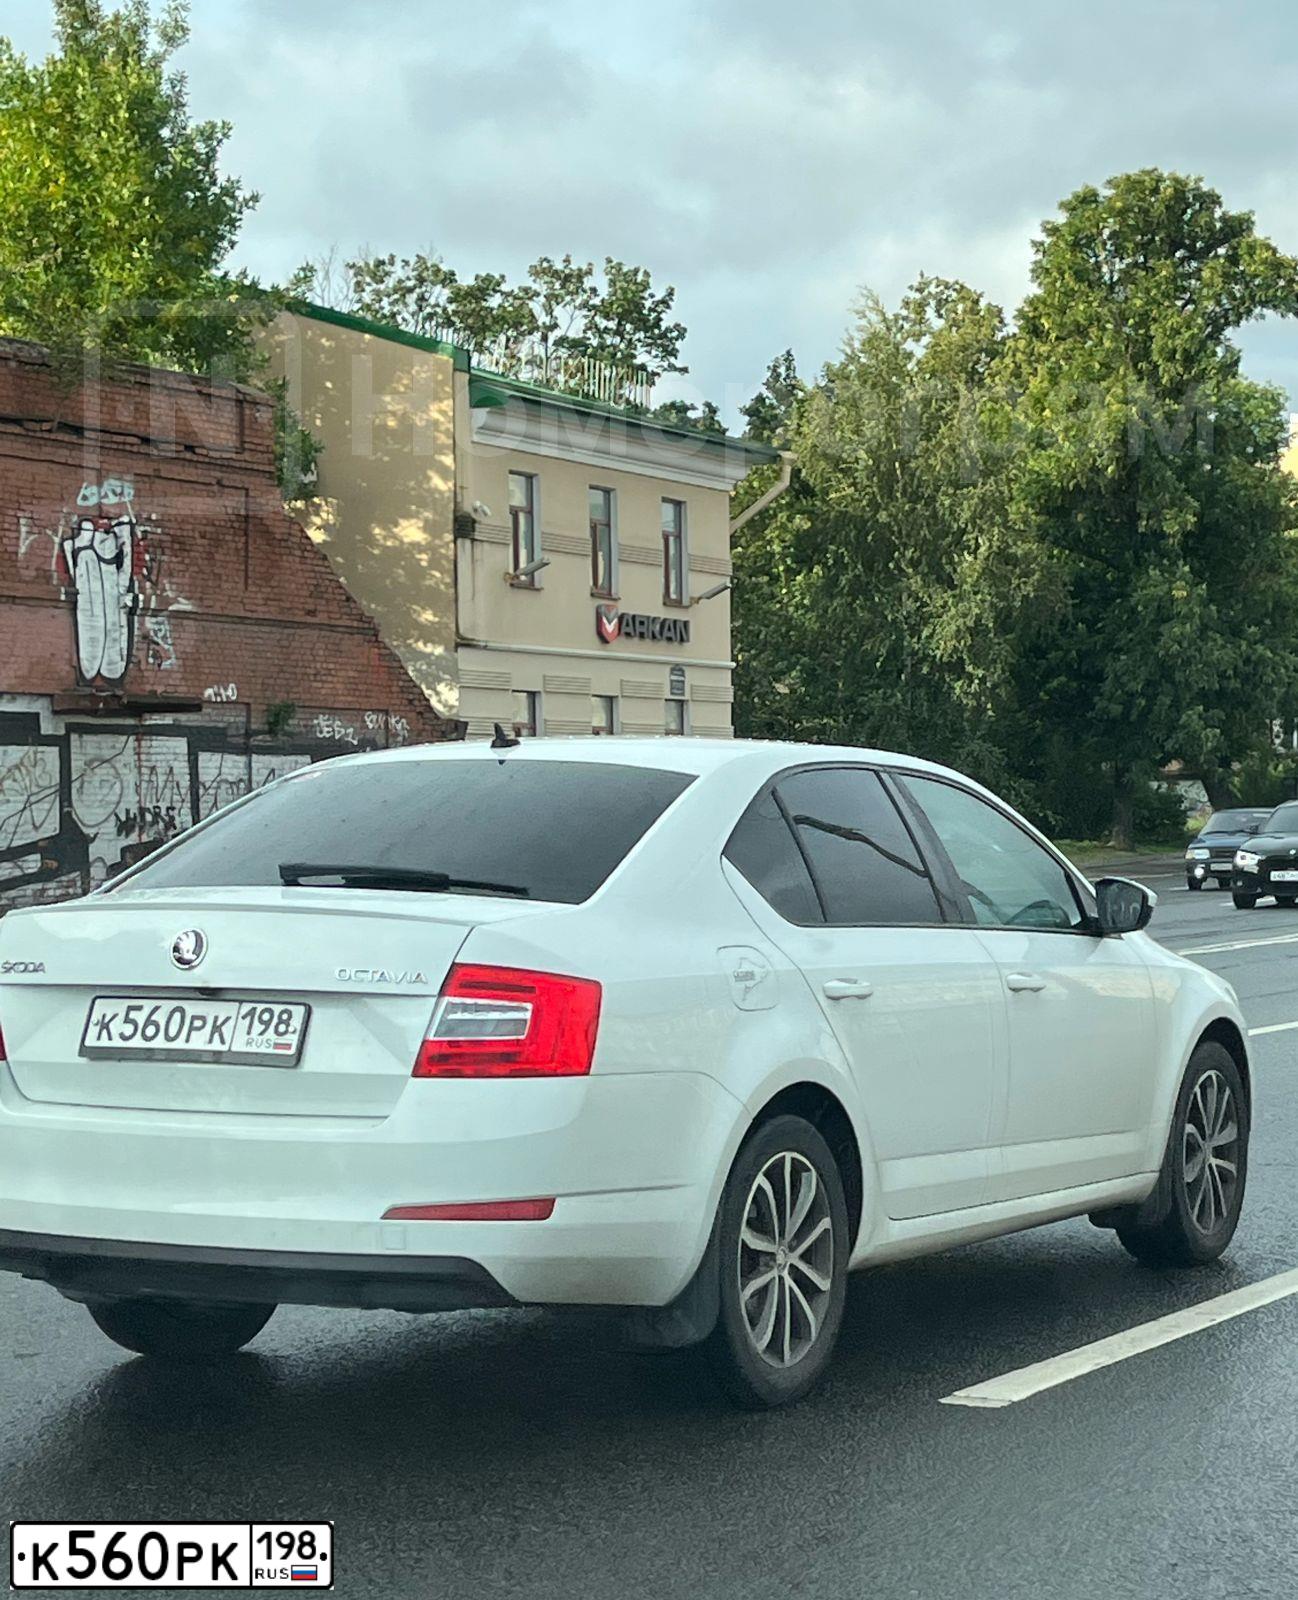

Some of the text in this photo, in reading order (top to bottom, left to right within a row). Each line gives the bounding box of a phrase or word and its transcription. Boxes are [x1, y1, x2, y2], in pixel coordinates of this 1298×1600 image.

[620, 613, 690, 643] ARKAN
[335, 967, 428, 984] OCTAVIA
[241, 1006, 294, 1037] 198
[245, 1038, 272, 1048] RUS
